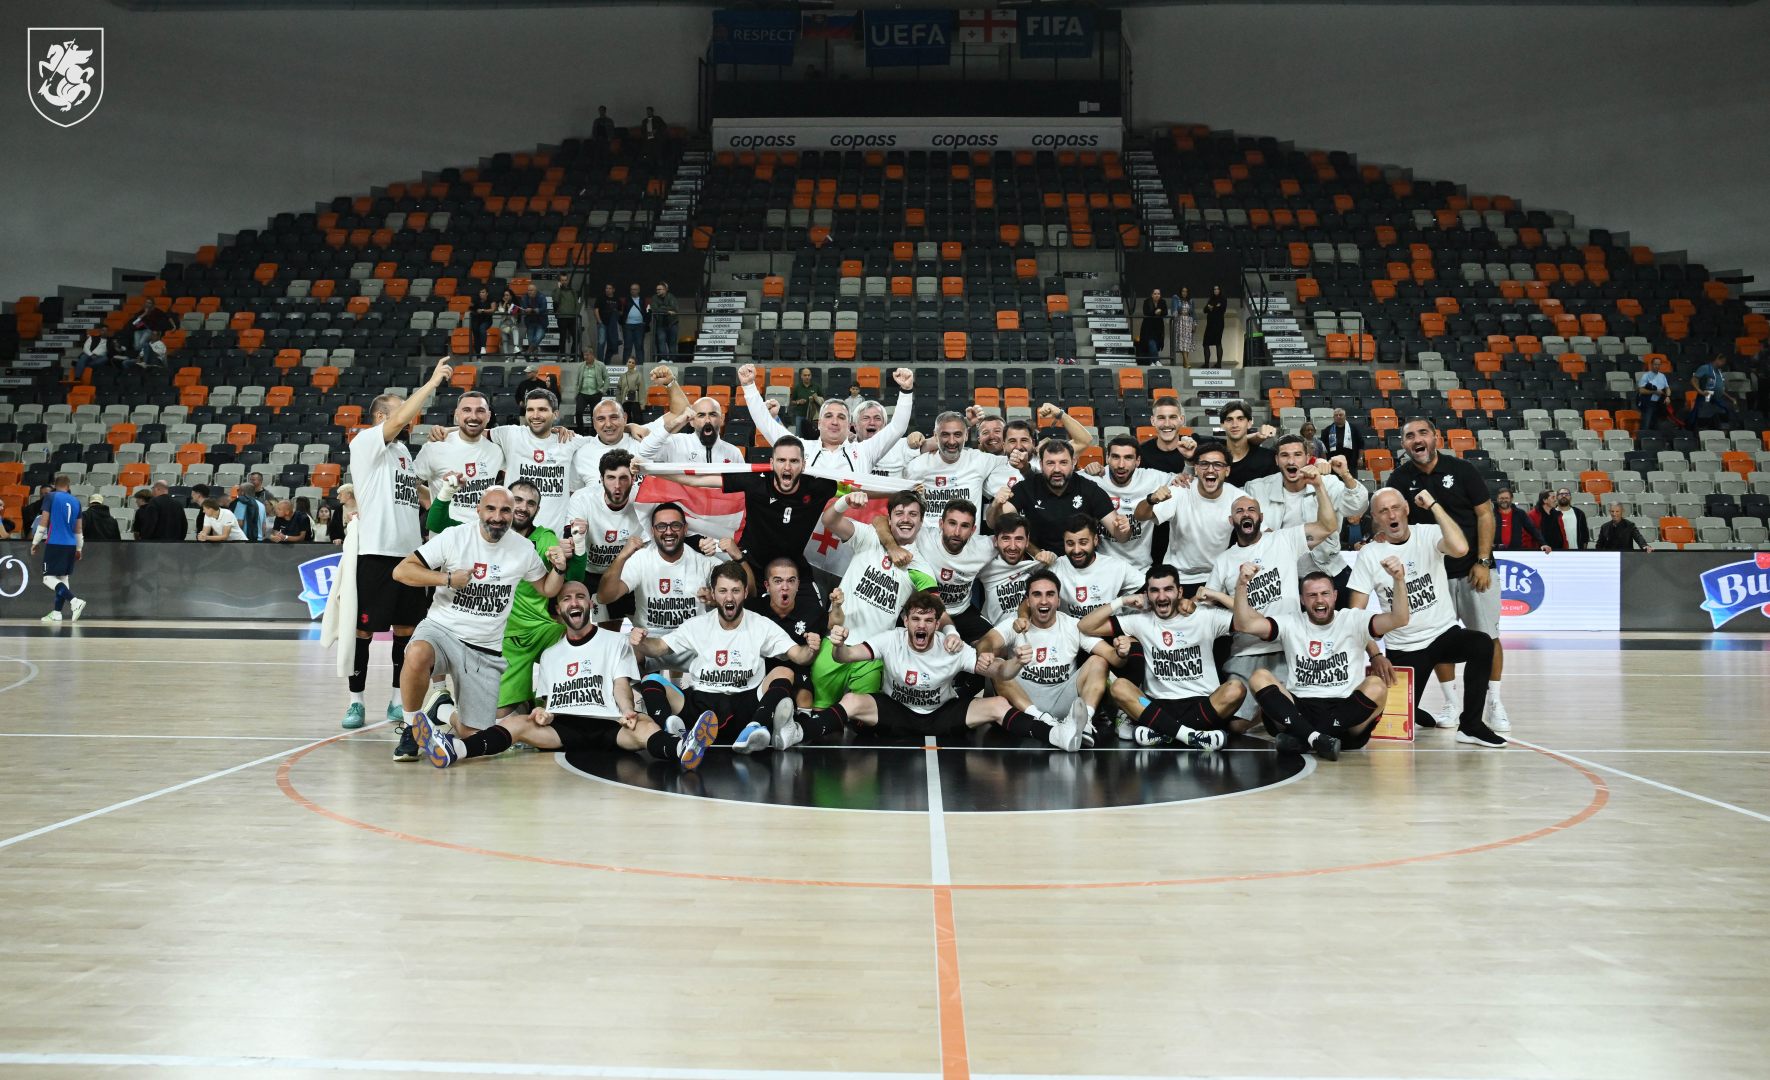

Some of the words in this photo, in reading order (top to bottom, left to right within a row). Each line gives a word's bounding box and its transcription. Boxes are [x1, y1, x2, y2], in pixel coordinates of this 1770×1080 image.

[733, 28, 795, 42] RESPECT
[871, 23, 945, 46] UEFA
[1026, 16, 1084, 36] FIFA
[66, 502, 72, 524] 1
[782, 506, 793, 524] 9
